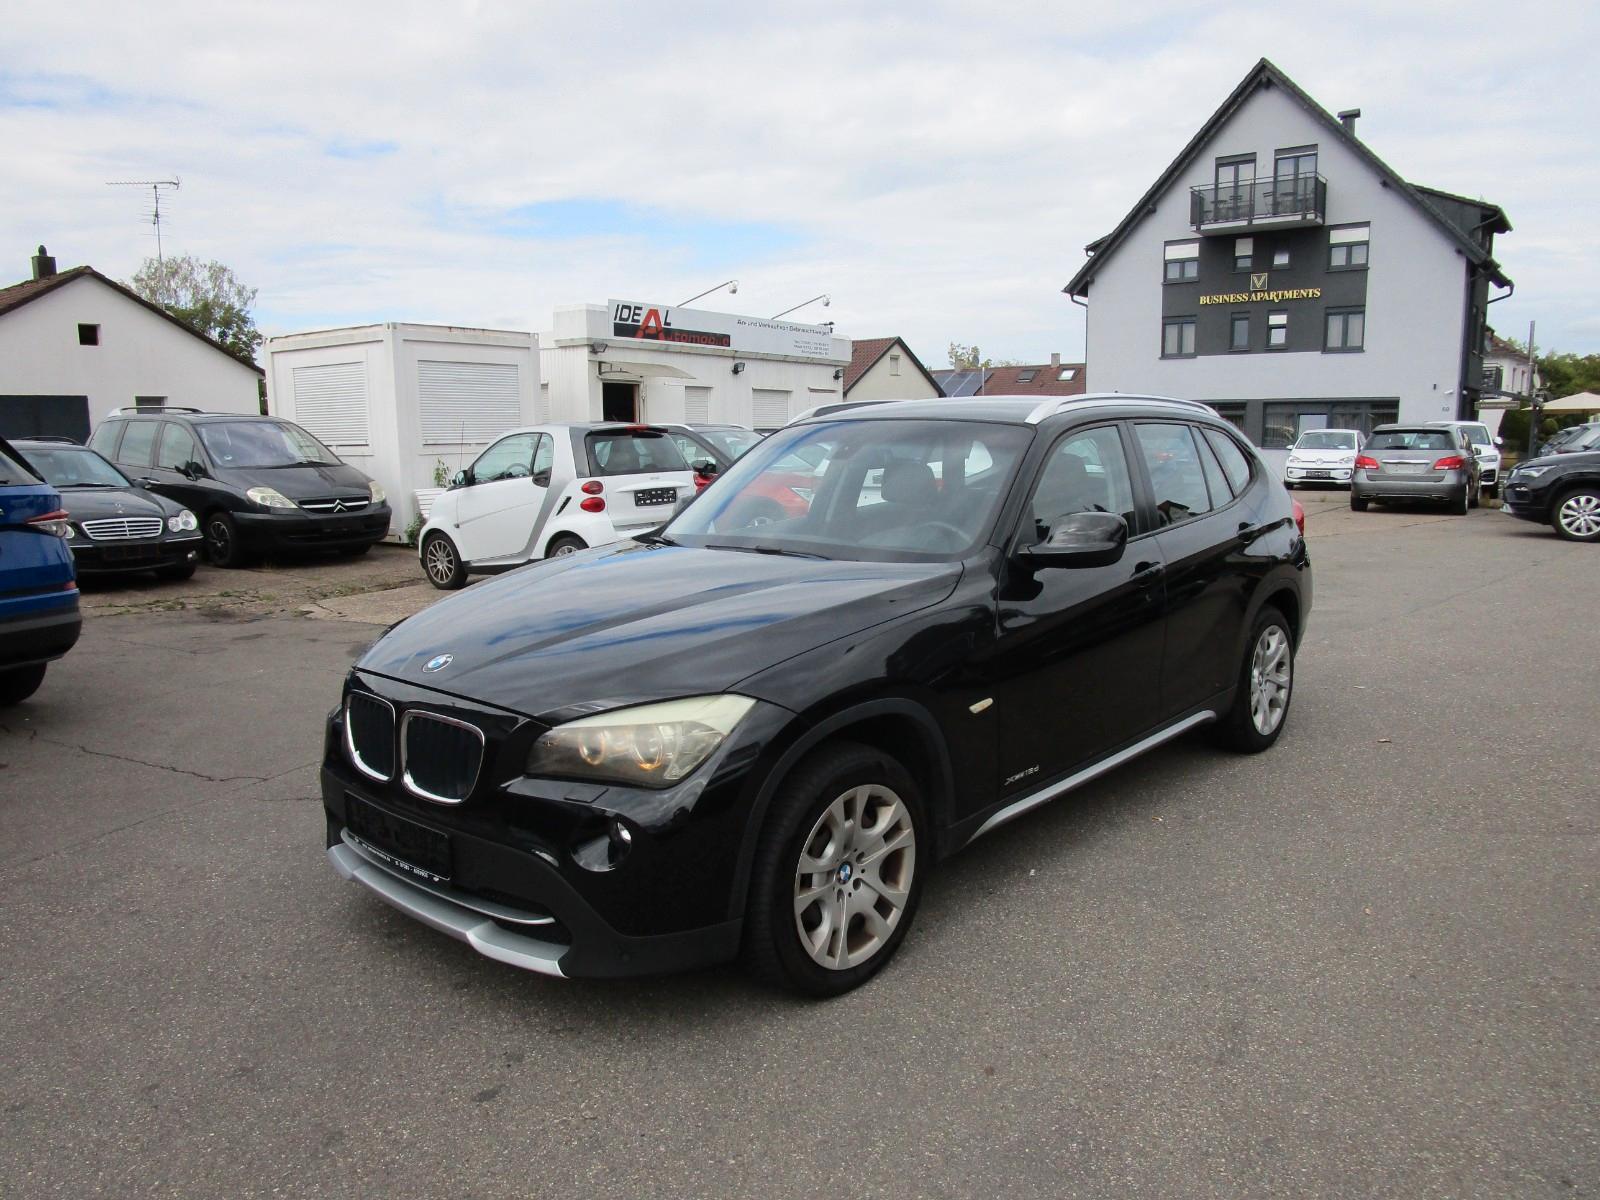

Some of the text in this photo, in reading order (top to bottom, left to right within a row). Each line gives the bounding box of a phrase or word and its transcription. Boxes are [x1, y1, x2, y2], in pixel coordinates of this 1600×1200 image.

[1199, 288, 1321, 305] BUSINESS APARTMENTS
[614, 304, 672, 341] IDEAL
